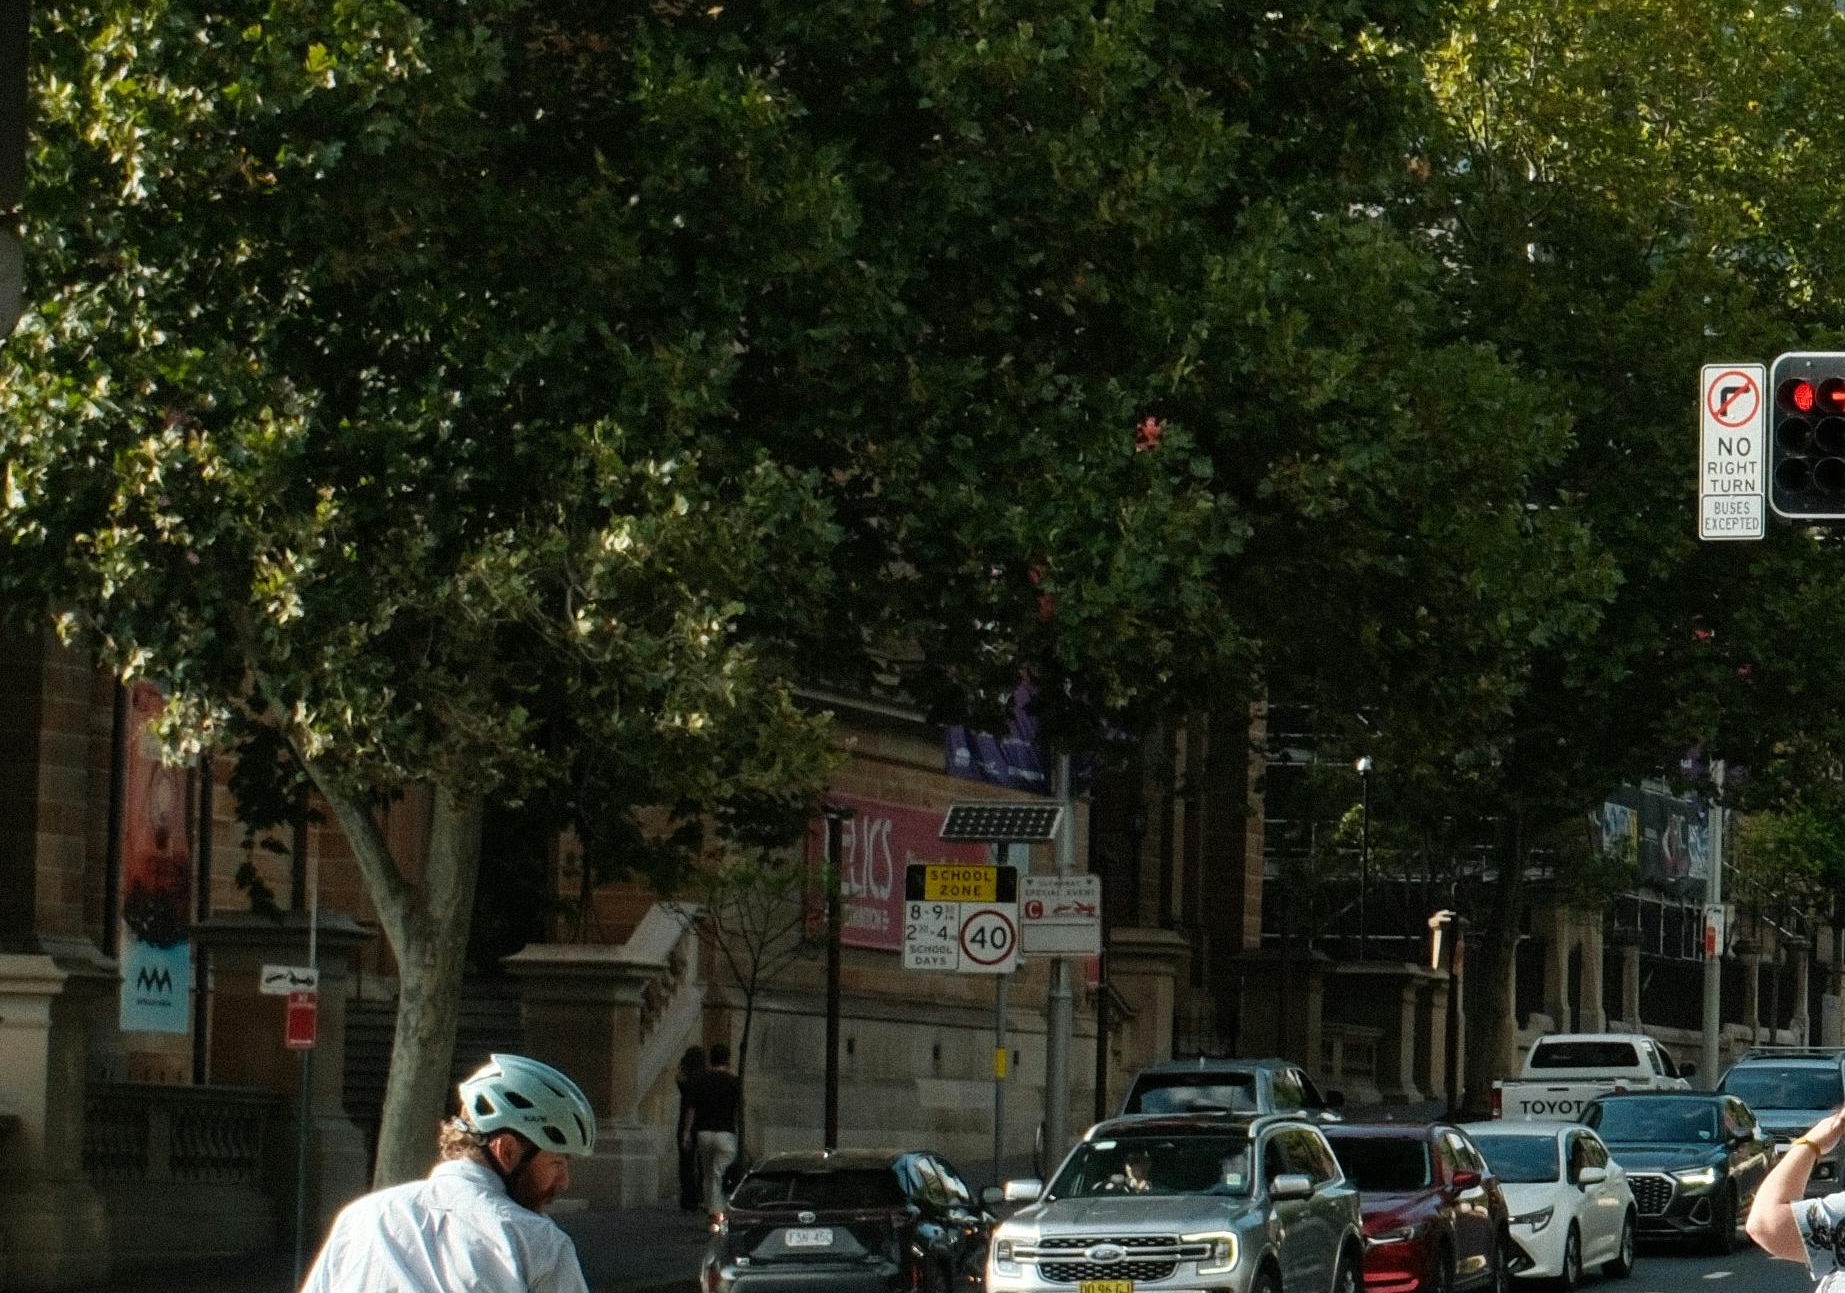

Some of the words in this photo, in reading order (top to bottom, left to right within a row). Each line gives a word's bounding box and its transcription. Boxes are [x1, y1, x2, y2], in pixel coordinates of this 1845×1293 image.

[1718, 437, 1752, 457] NO
[1707, 461, 1758, 475] RIGHT
[1710, 479, 1756, 493] TURN
[1714, 501, 1751, 515] BUSES
[1705, 517, 1760, 531] EXCEPTED
[930, 870, 992, 882] SCHOOL
[940, 885, 982, 896] ZONE
[969, 925, 1008, 950] 40
[910, 944, 953, 955] SCHOOL
[915, 956, 947, 966] DAYS
[1520, 1100, 1585, 1115] TOYOT
